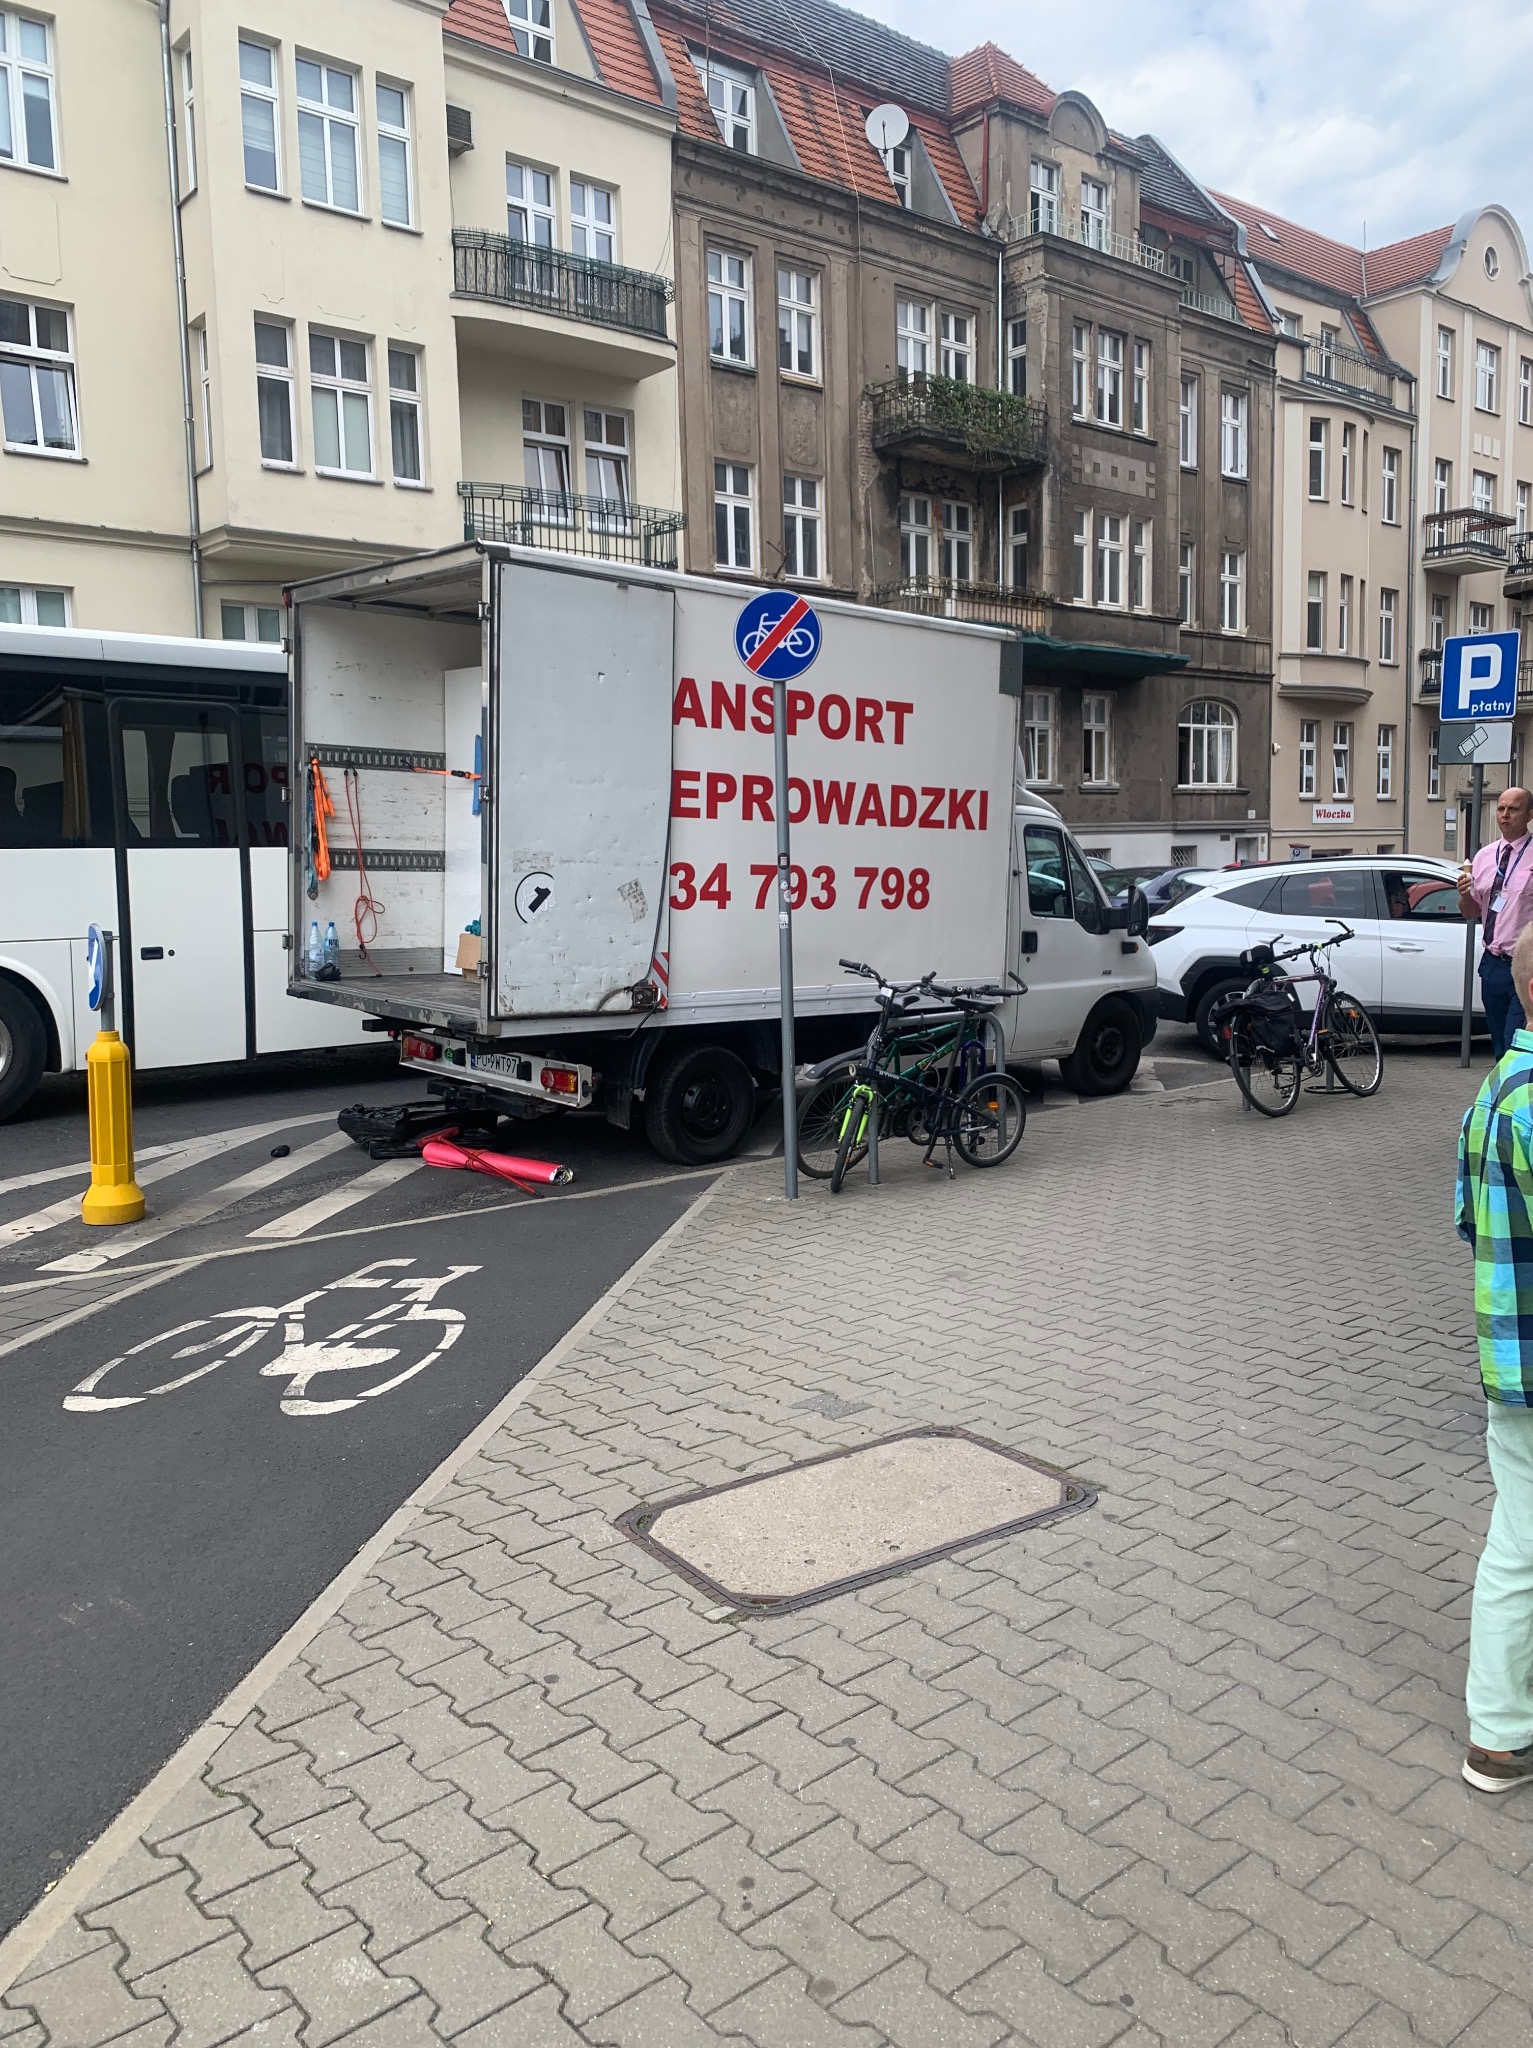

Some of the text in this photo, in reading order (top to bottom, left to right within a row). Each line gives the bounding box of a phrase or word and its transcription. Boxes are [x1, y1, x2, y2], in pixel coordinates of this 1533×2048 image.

[1458, 643, 1503, 710] P
[1470, 701, 1512, 715] płatny
[750, 863, 837, 910] 793
[854, 866, 931, 910] 798
